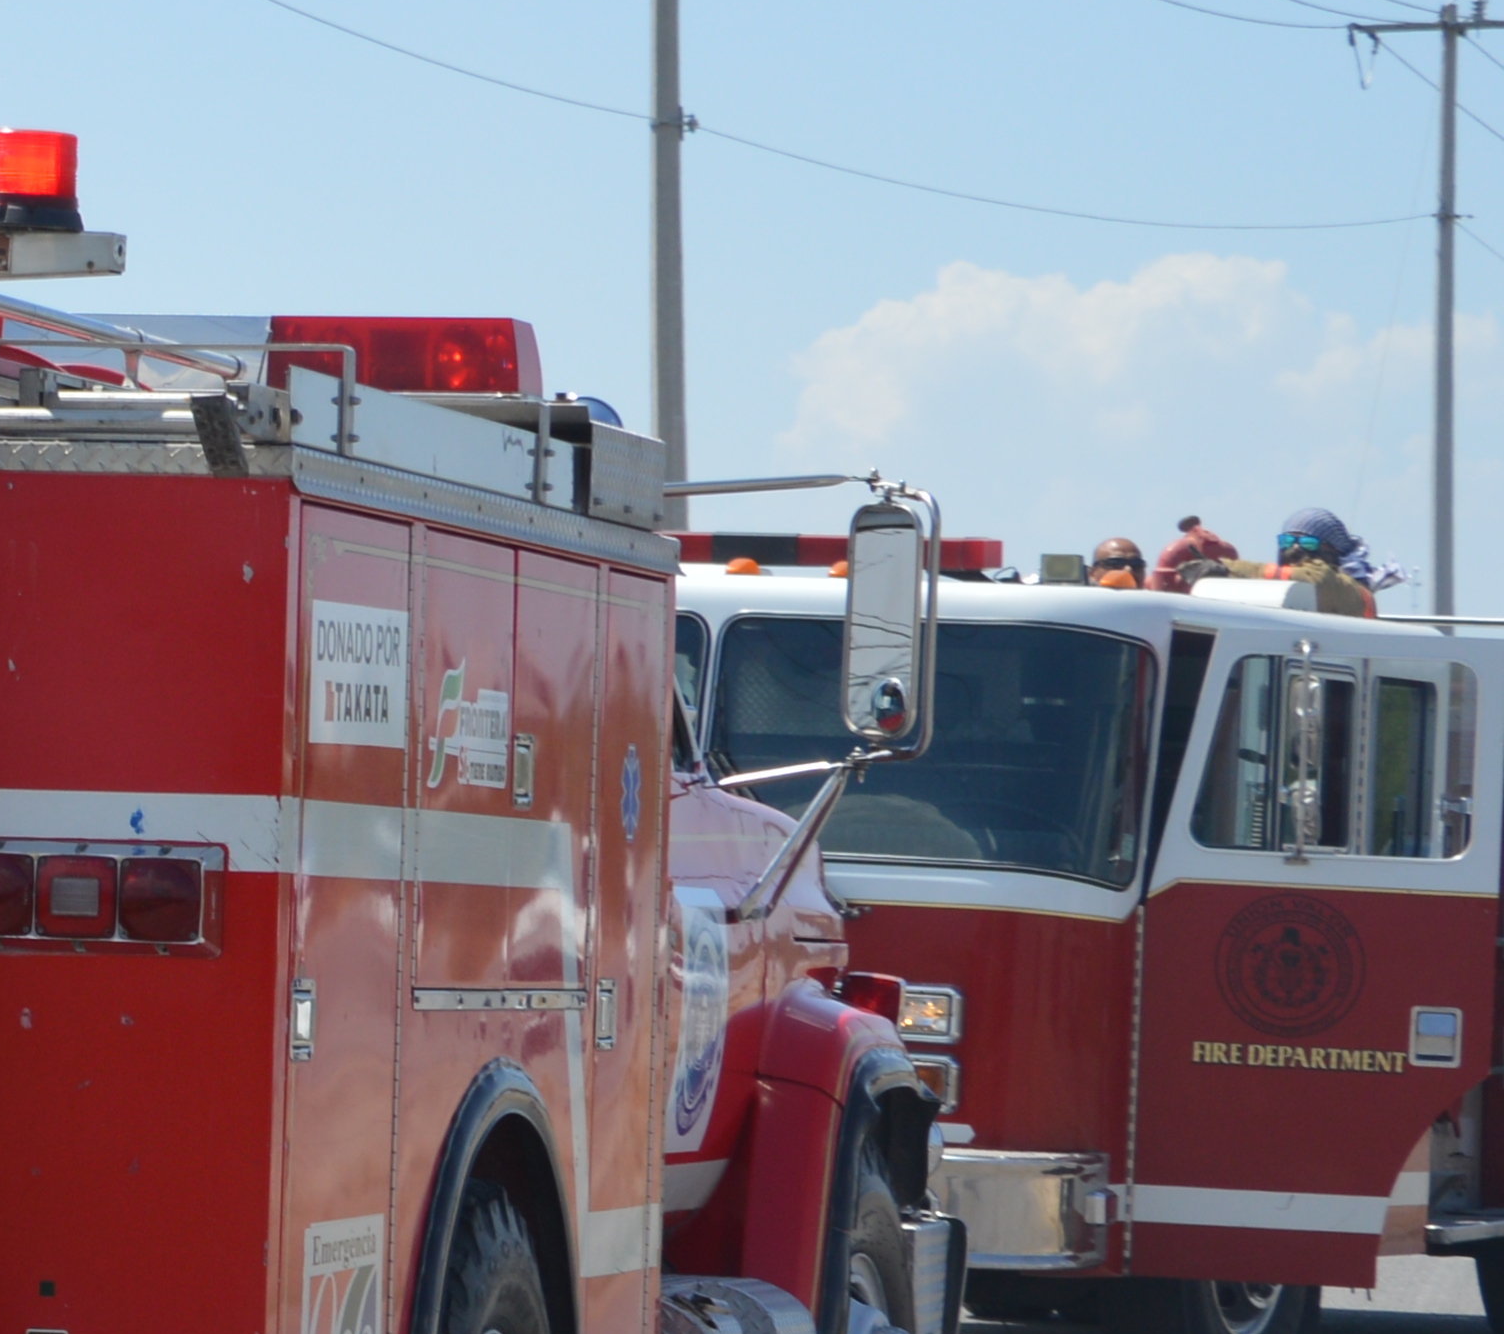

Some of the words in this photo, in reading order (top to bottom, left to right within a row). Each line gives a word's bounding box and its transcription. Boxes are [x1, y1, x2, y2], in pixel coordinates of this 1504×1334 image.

[317, 619, 373, 665] DONADO
[375, 623, 401, 668] POR
[334, 682, 389, 724] TAKATA
[1191, 1041, 1243, 1064] FIRE
[1247, 1044, 1407, 1074] DEPARTMENT
[312, 1225, 377, 1268] Emergencia
